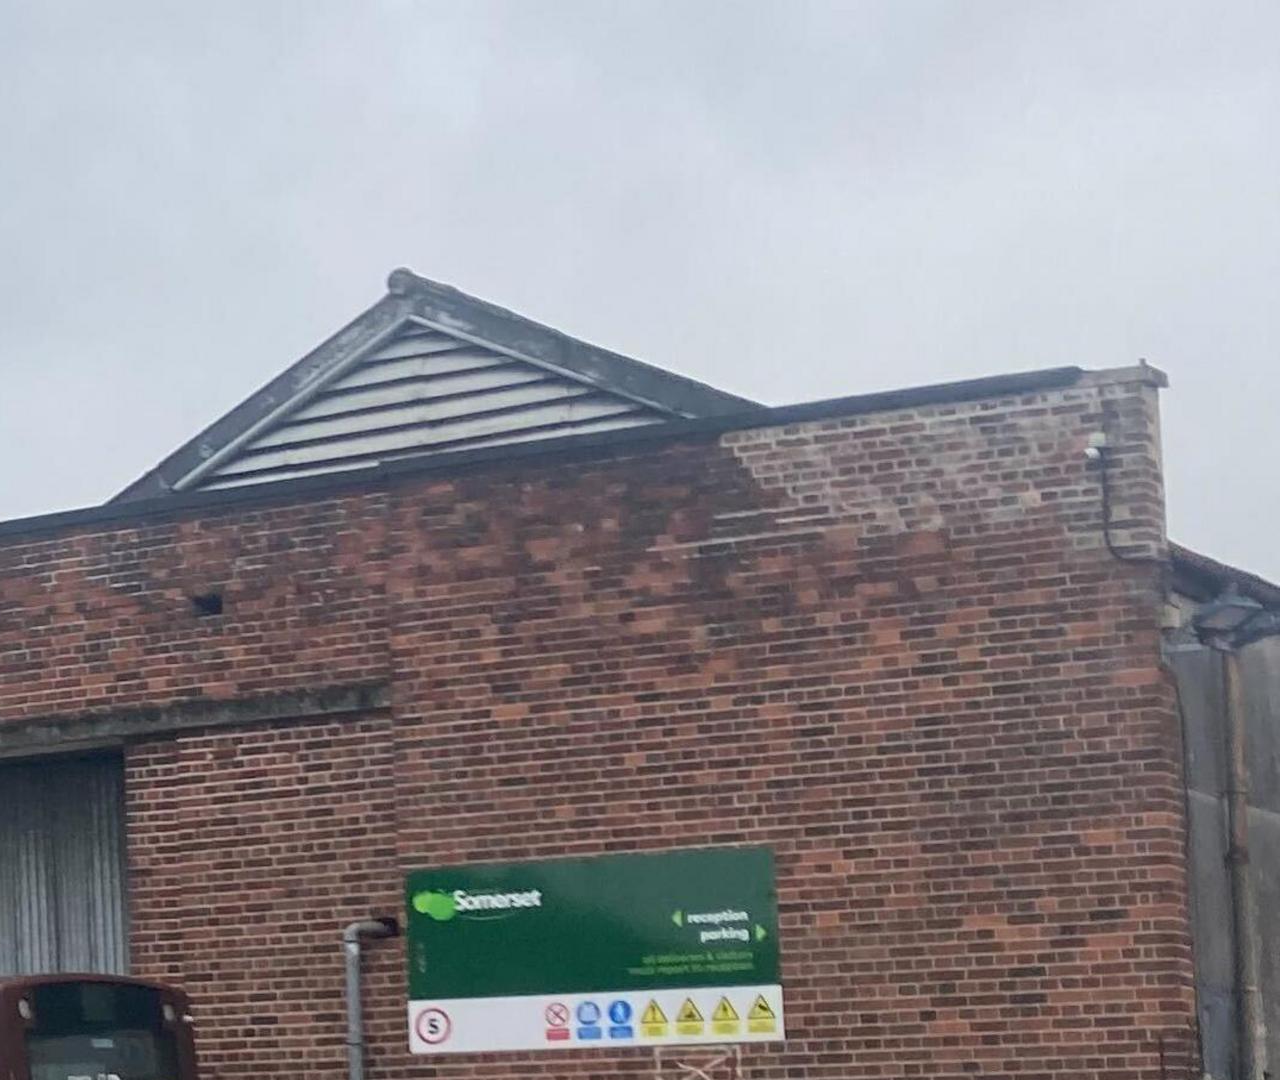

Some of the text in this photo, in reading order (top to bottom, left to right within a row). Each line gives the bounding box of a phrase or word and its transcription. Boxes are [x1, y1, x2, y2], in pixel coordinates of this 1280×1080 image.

[453, 890, 542, 911] Somerset
[687, 909, 749, 924] reception
[700, 927, 750, 943] parking
